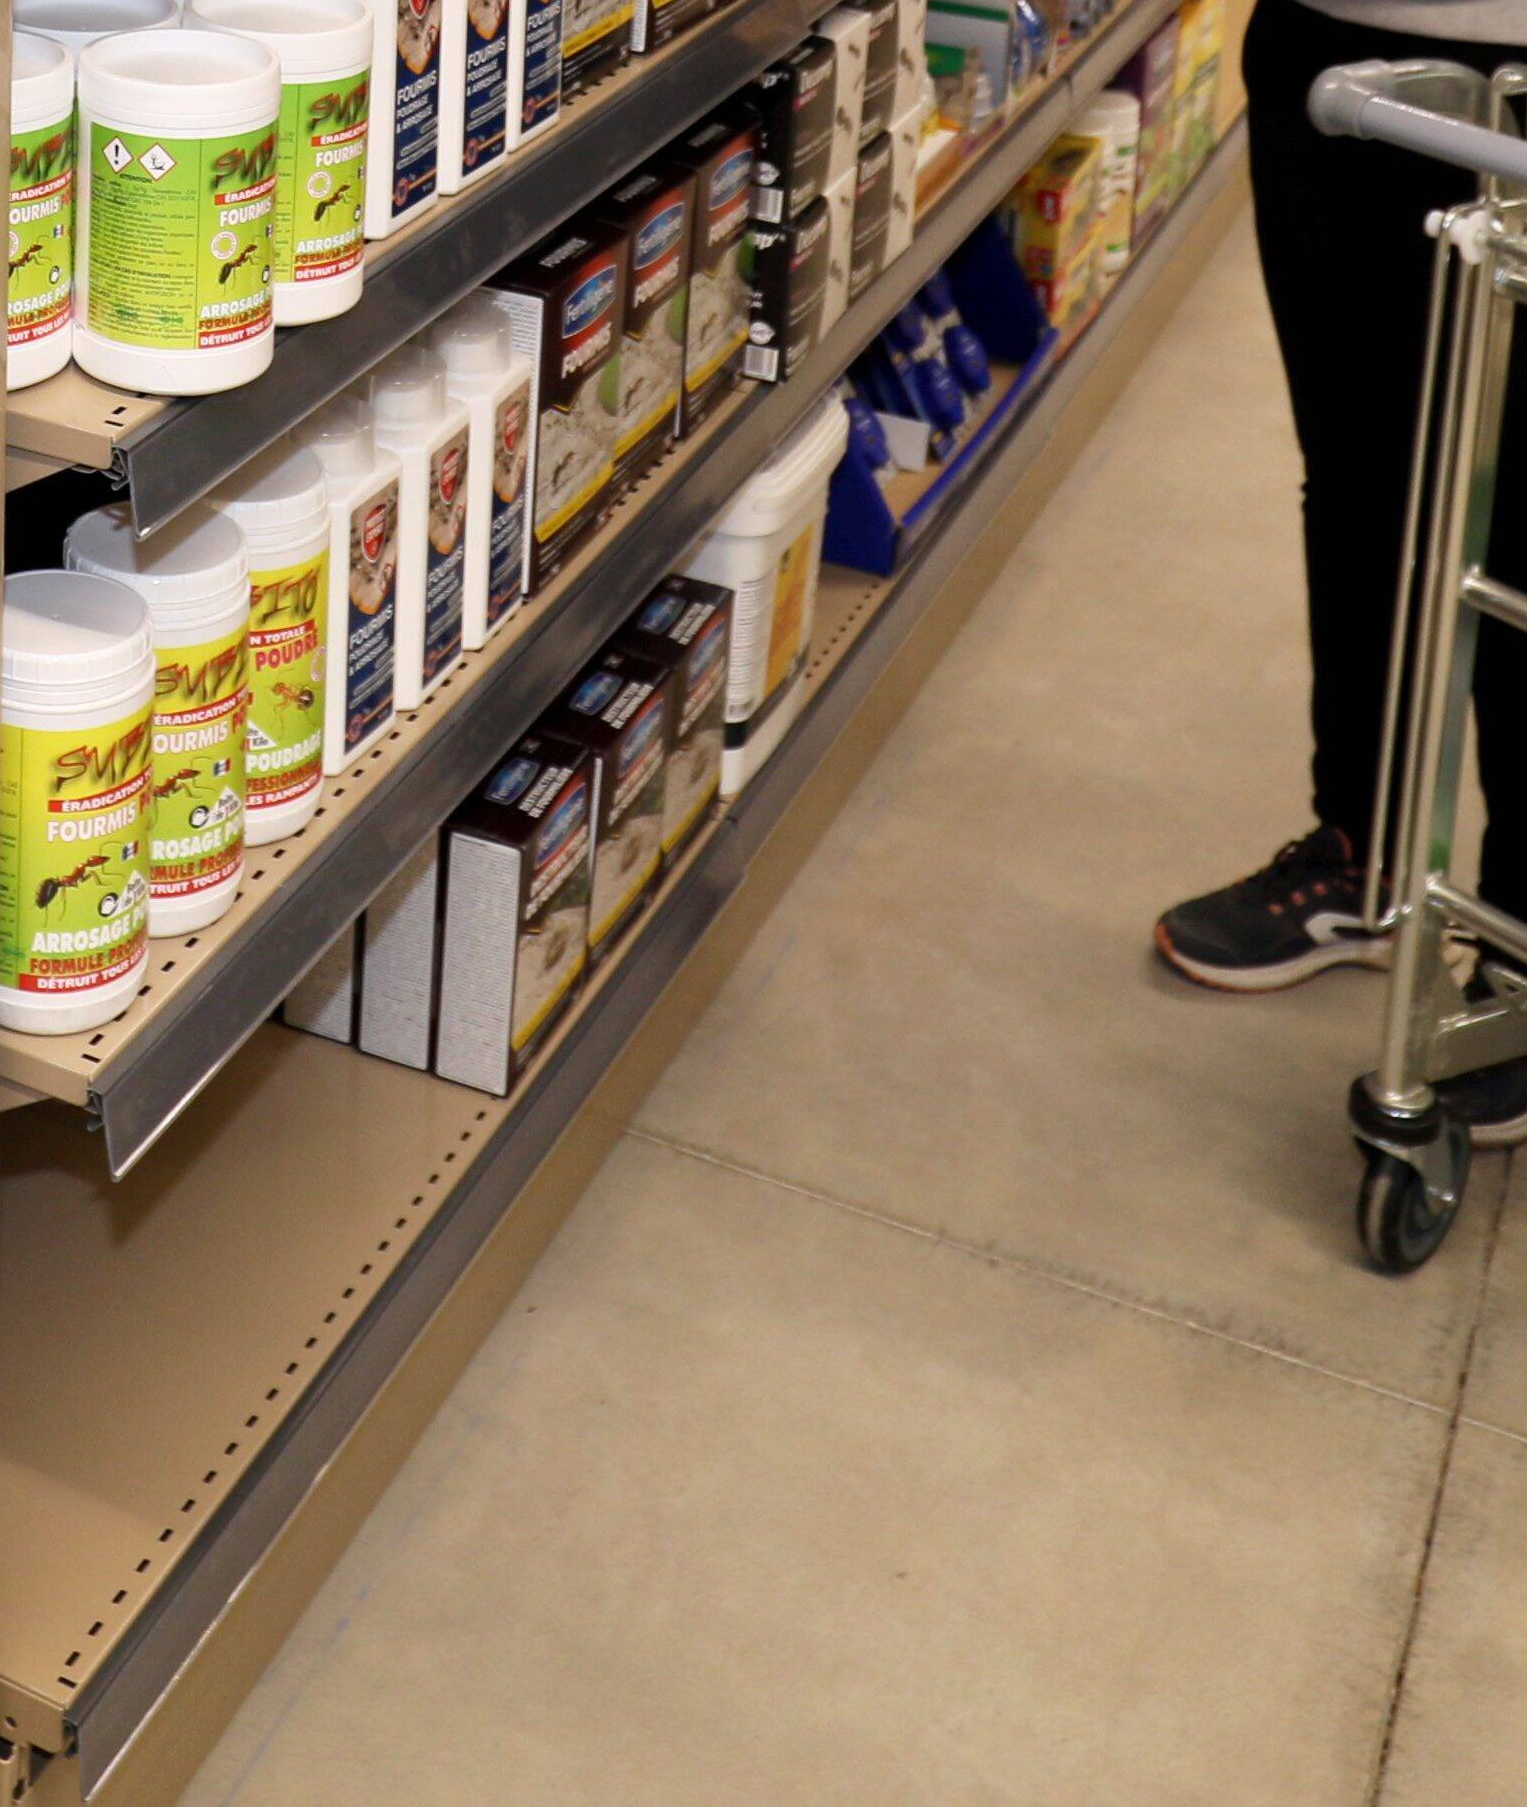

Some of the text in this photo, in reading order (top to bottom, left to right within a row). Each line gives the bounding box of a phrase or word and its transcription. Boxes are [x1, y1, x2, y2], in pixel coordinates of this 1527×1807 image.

[468, 36, 506, 69] FOURMIS
[397, 70, 437, 103] FOURMIS
[219, 199, 272, 228] FOURMIS
[200, 294, 269, 319] ARROSAGE
[351, 605, 393, 648] FOURMIS
[256, 633, 318, 672] POUDRE
[246, 734, 321, 774] POUDRAGE
[49, 803, 138, 845] FOURMIS
[32, 916, 131, 955] ARROSAGE
